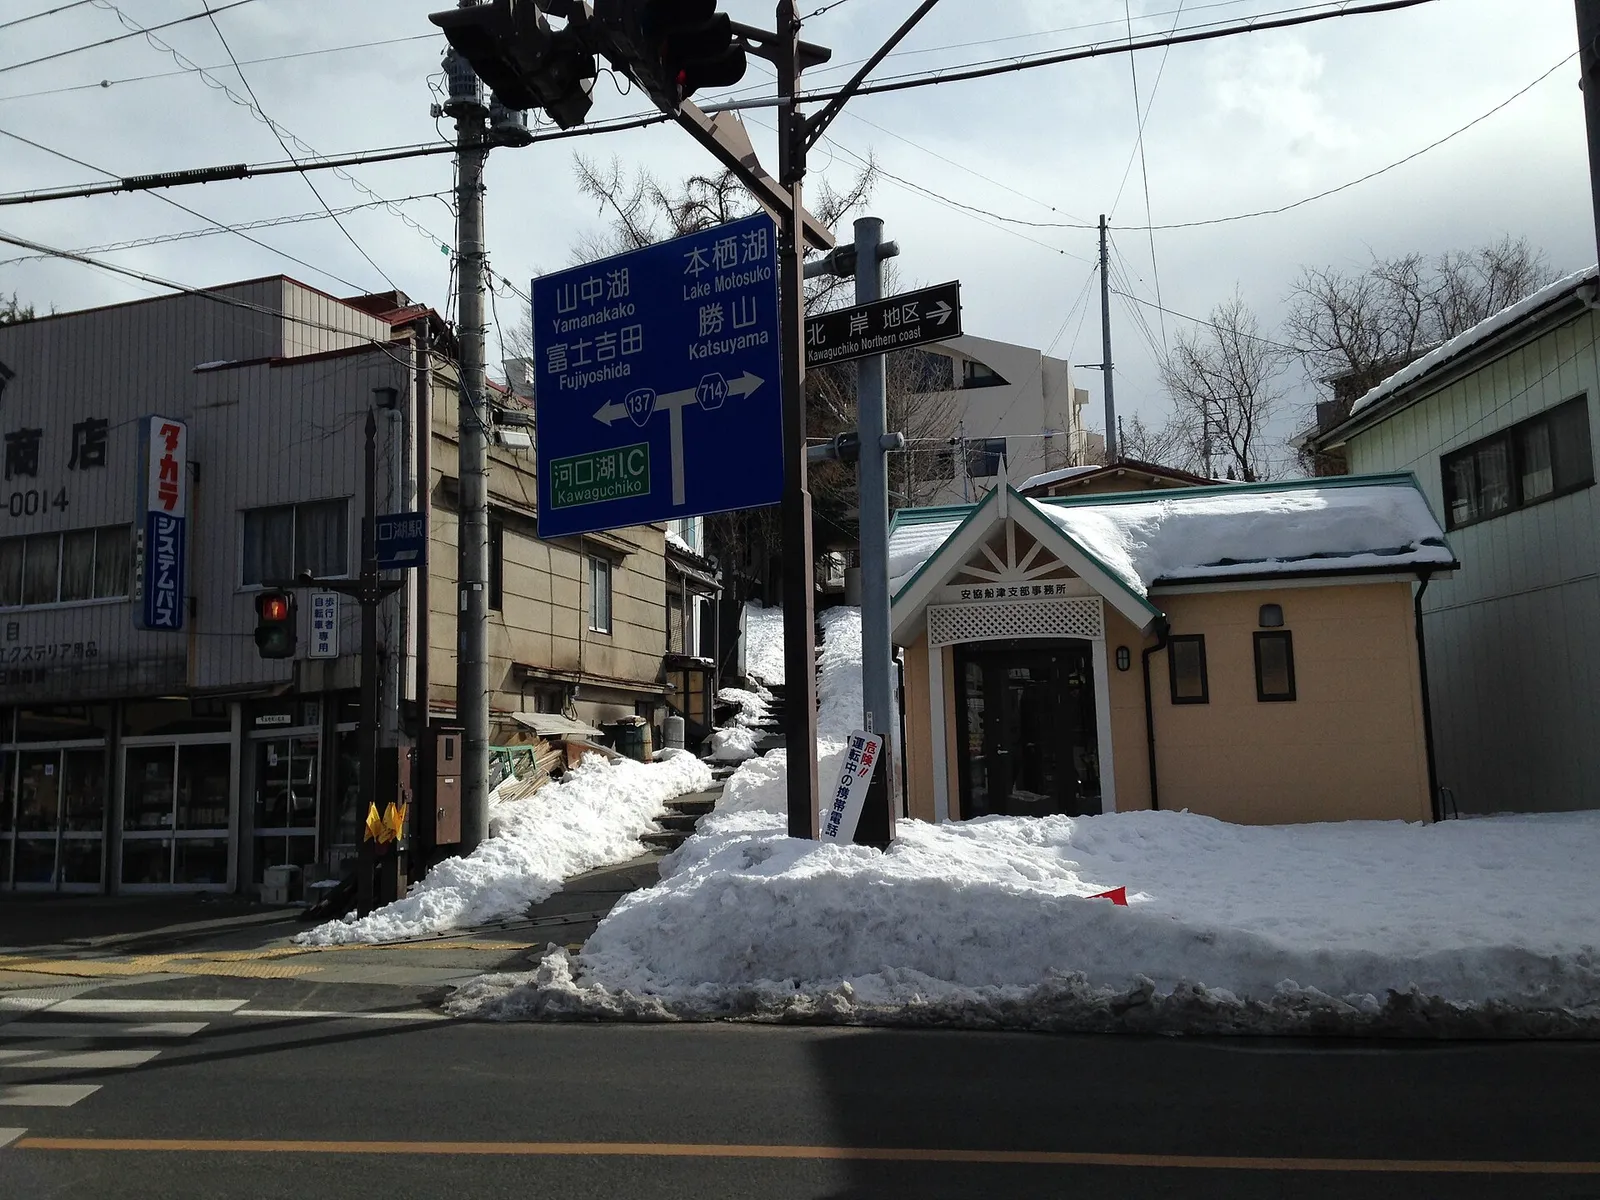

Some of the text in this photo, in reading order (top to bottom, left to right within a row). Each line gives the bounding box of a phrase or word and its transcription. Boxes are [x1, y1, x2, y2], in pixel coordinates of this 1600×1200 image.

[684, 227, 768, 278] 本栖湖
[556, 267, 630, 314] 山中湖
[683, 265, 771, 301] Lake Motosuko
[553, 302, 635, 334] Yamanakako
[699, 296, 757, 337] 勝山
[546, 323, 643, 374] 富士吉田
[689, 330, 769, 361] Katsuyama
[808, 324, 922, 362] Kawaguchiko Northern coast
[559, 361, 631, 391] Fujiyoshida
[701, 381, 723, 402] 714
[628, 393, 651, 414] 137
[159, 423, 181, 511] タカラ
[558, 479, 642, 505] Kawaguchiko
[154, 516, 177, 627] システムバス
[961, 583, 1067, 600] 安協船津支部事務所
[318, 631, 329, 653] 専用
[825, 736, 866, 838] 運転中の携帯電話
